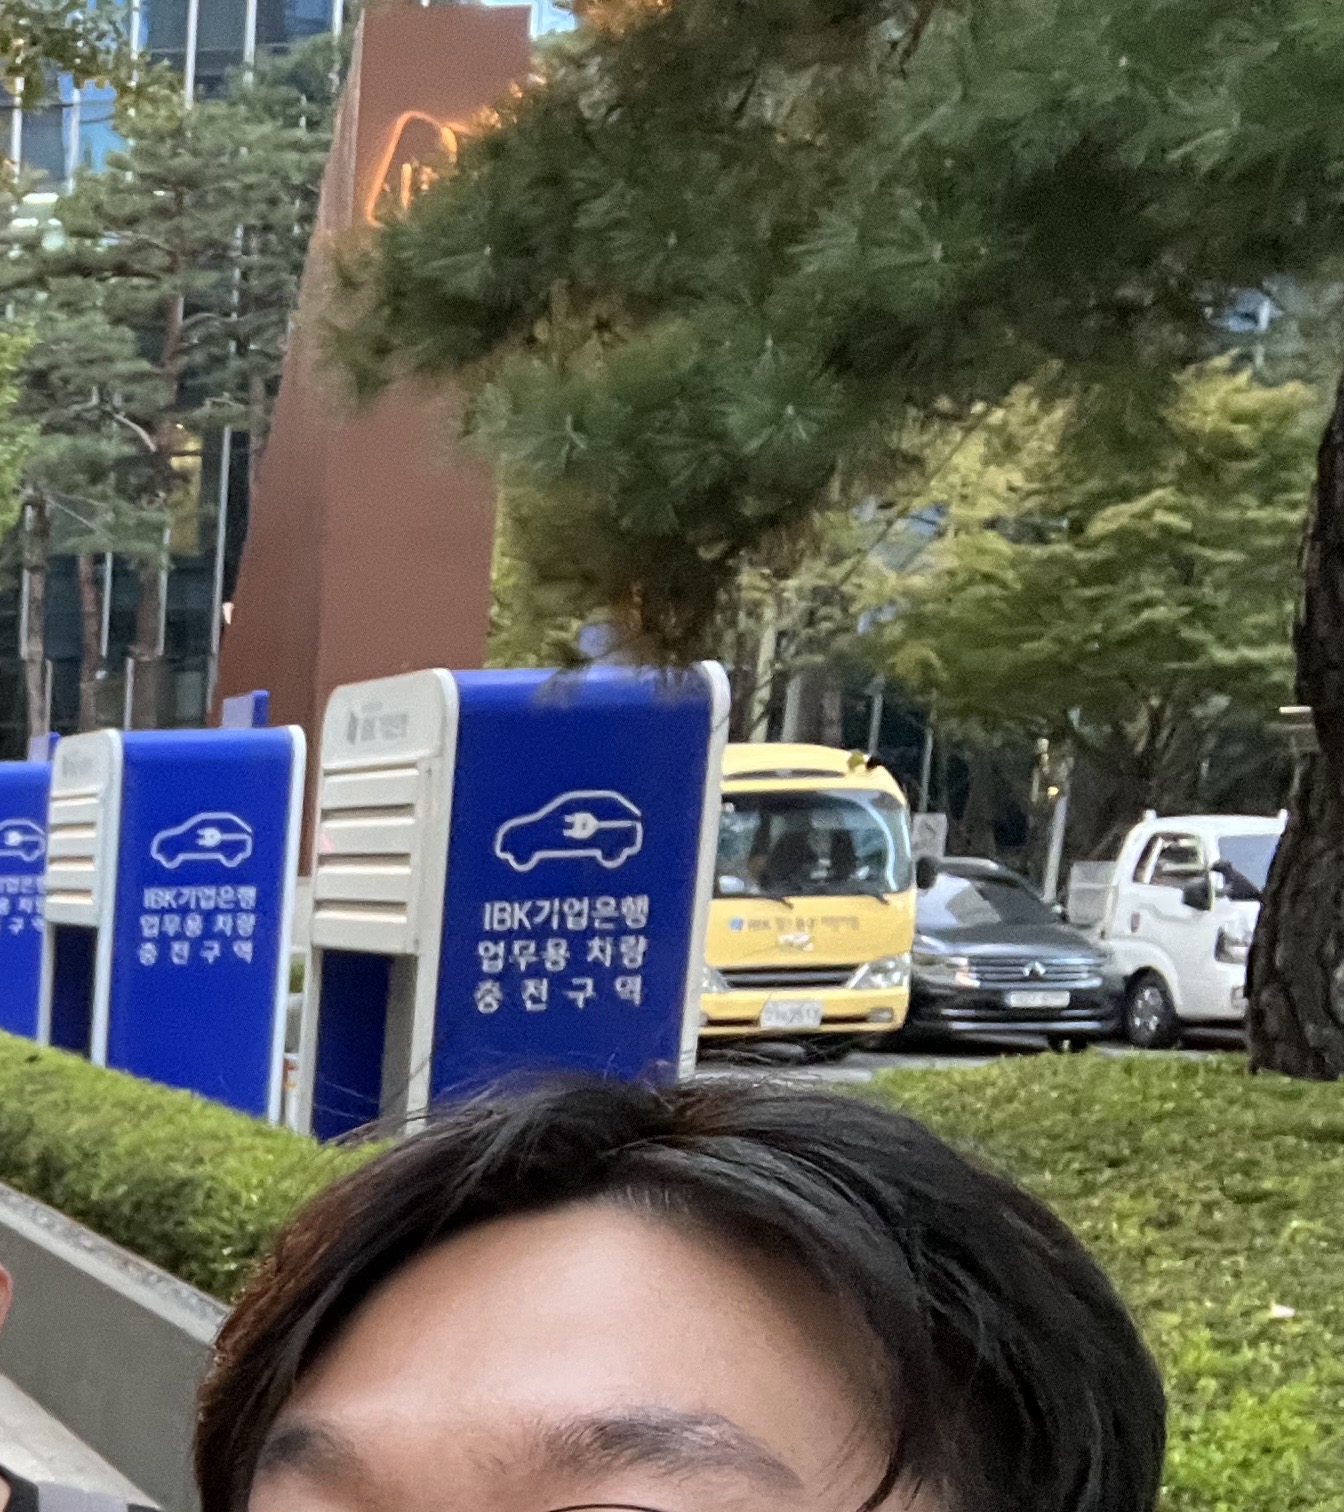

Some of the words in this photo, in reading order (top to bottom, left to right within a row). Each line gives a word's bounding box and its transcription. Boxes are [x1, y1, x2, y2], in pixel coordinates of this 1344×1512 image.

[143, 885, 257, 910] IBK기업은행
[483, 894, 650, 931] IBK기업은행
[477, 938, 571, 974] 업무용
[586, 934, 650, 970] 차량
